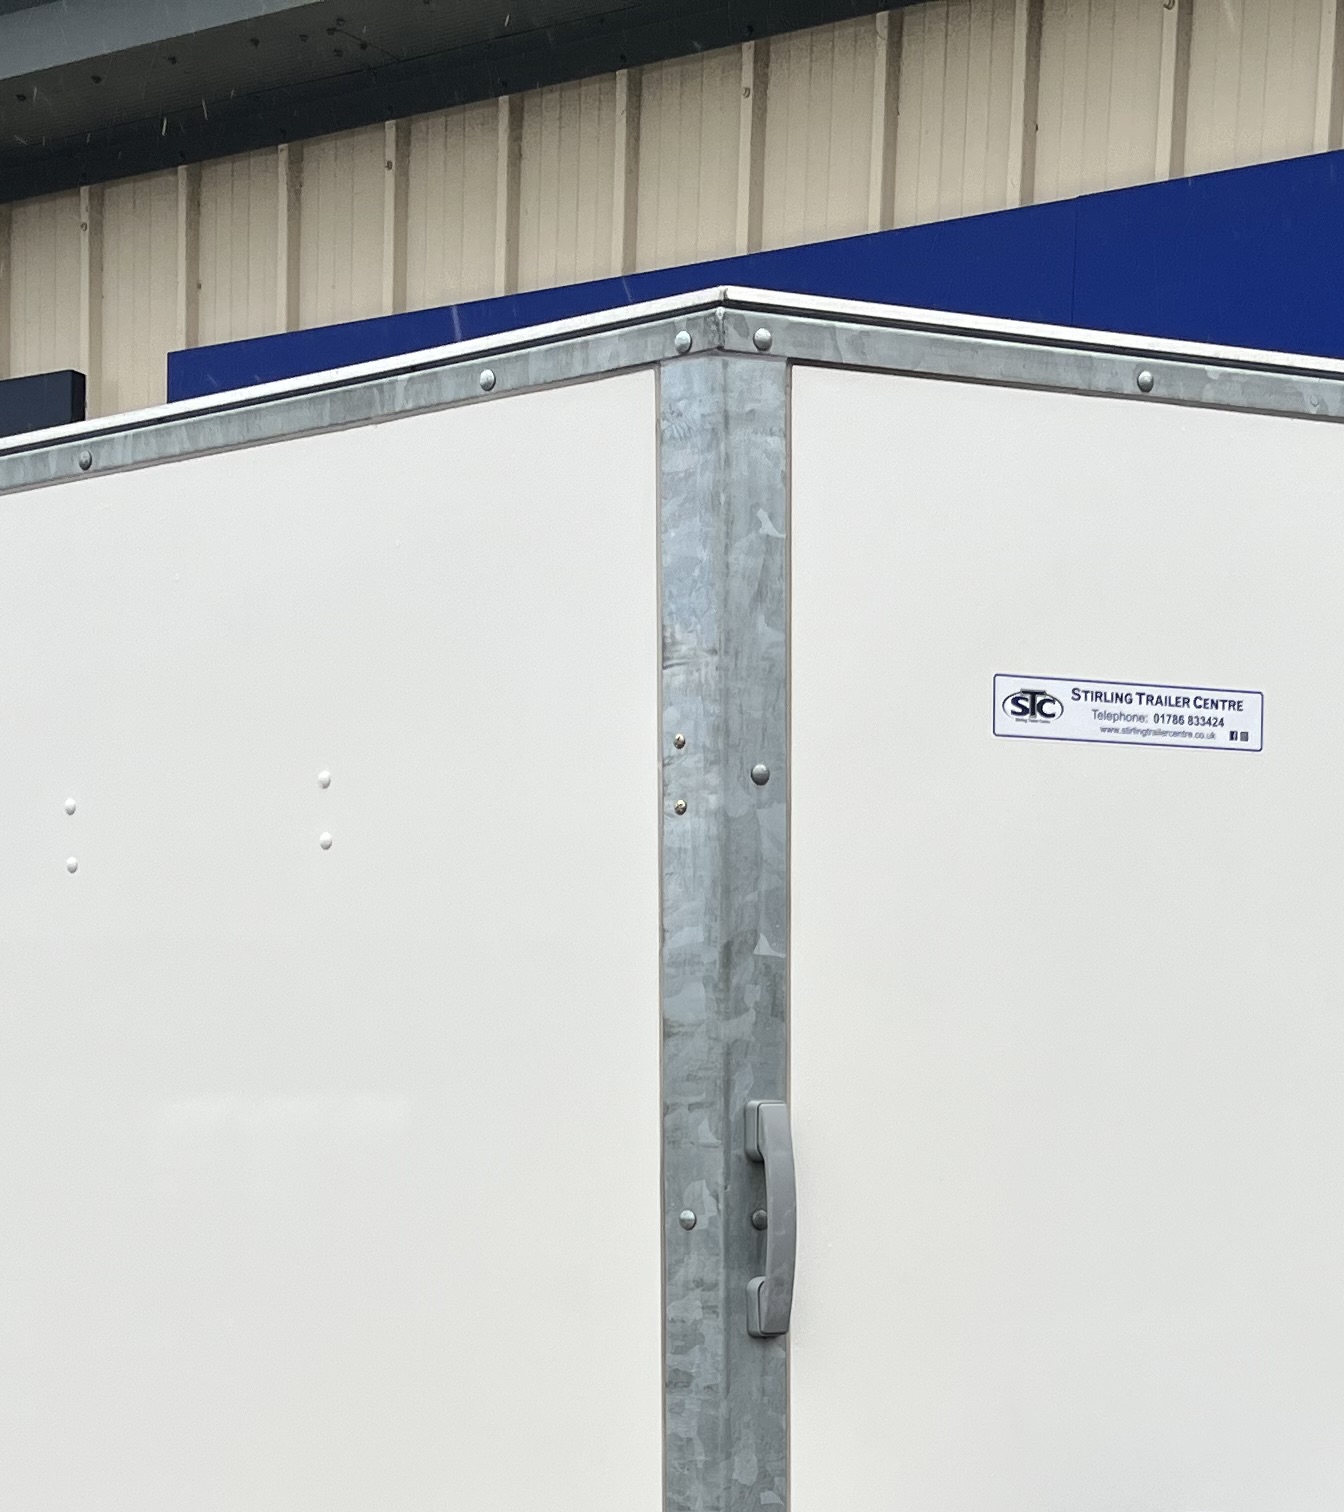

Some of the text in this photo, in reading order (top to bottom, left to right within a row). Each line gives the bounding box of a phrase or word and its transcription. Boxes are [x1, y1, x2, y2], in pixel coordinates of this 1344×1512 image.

[1010, 688, 1057, 719] STC
[1070, 687, 1244, 712] STIRLING TRAILER CENTRE
[1152, 713, 1185, 726] 01786
[1187, 714, 1225, 728] 833424
